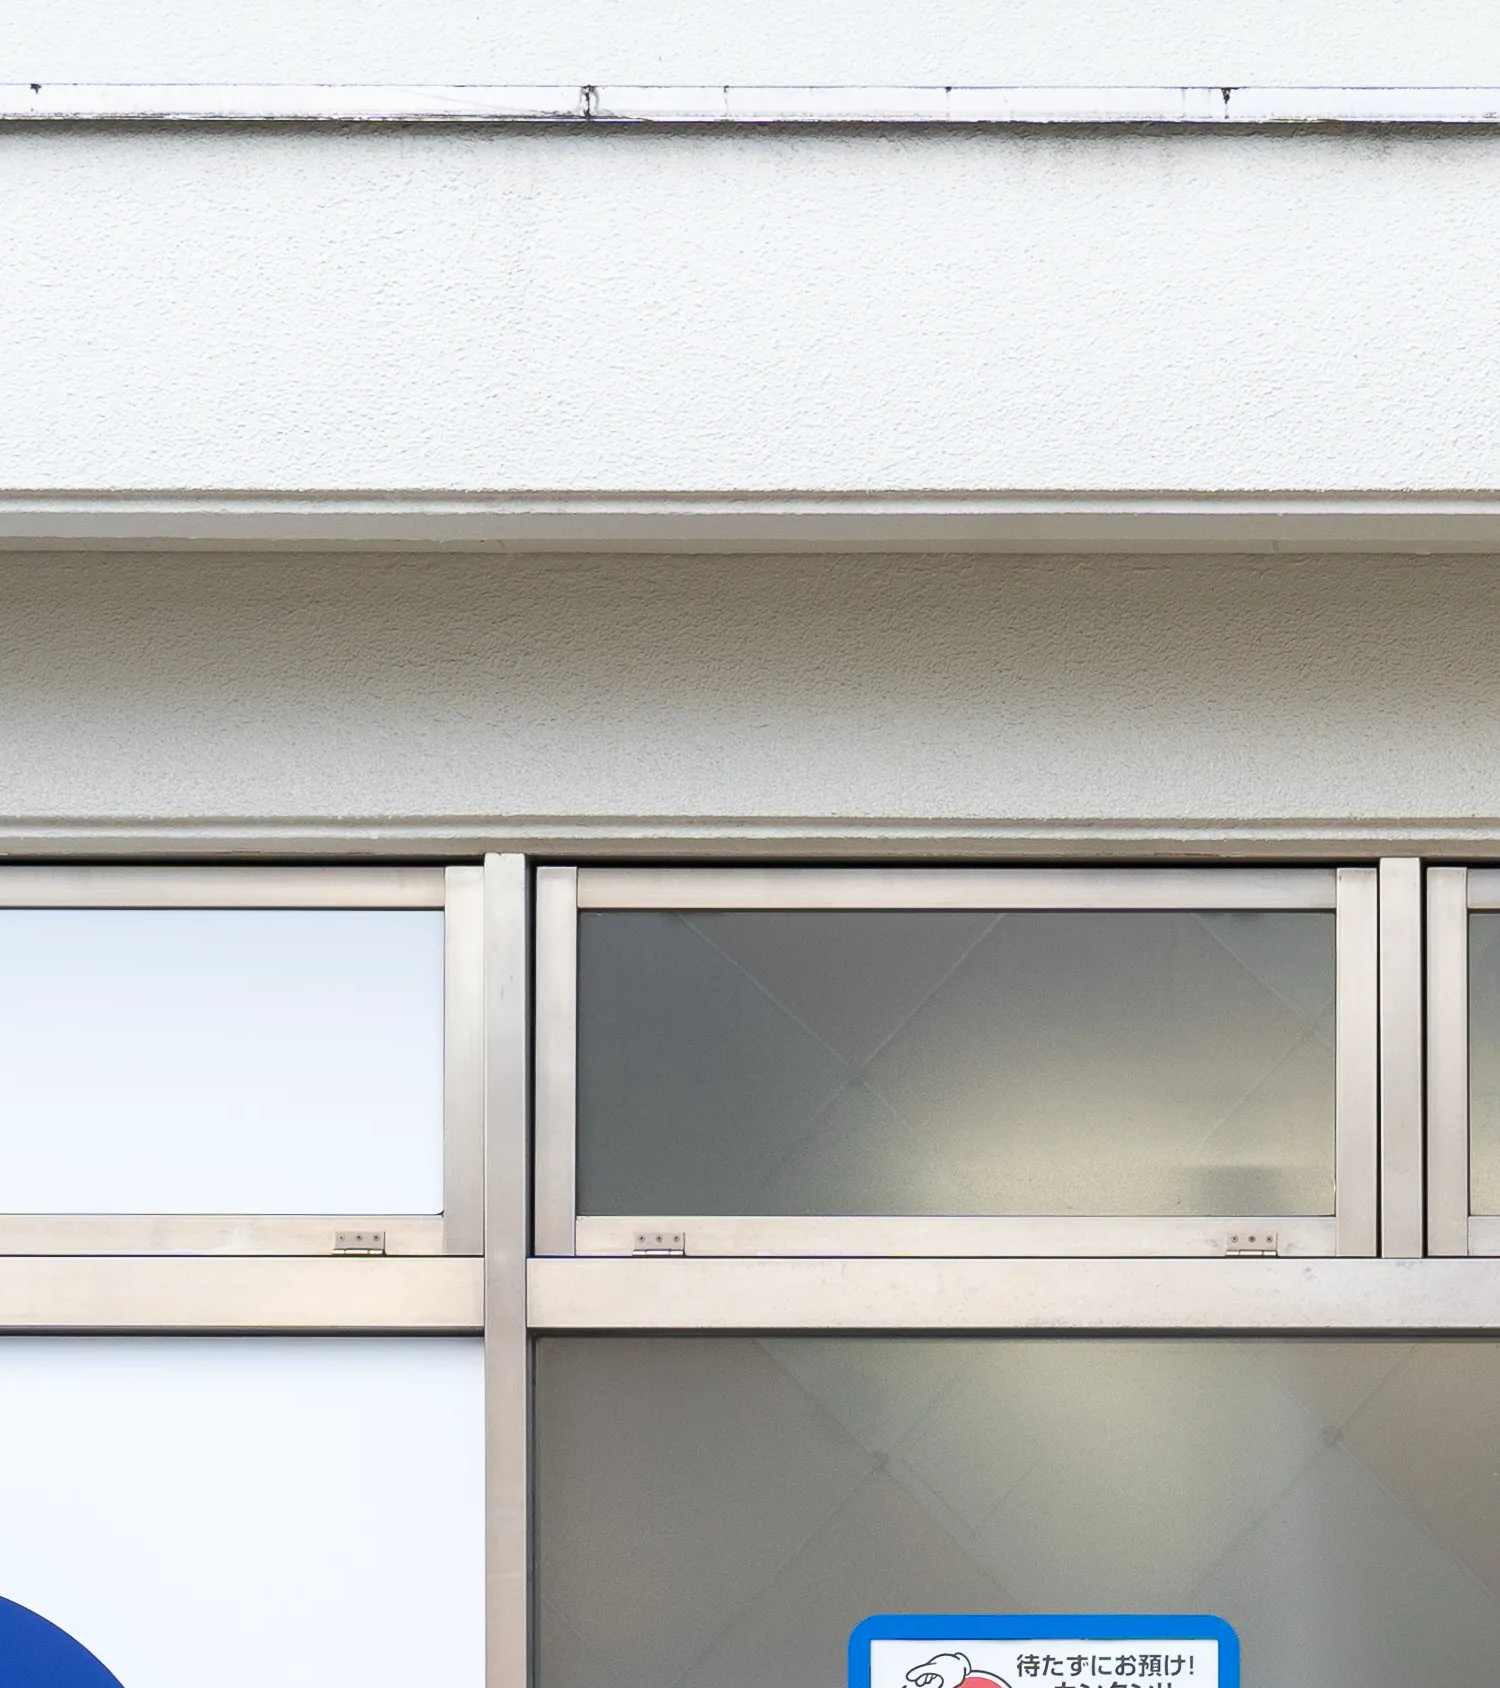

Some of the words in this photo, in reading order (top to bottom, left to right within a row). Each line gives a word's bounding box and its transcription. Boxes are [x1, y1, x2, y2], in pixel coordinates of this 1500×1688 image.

[1016, 1653, 1195, 1677] 待たずにお預け!
